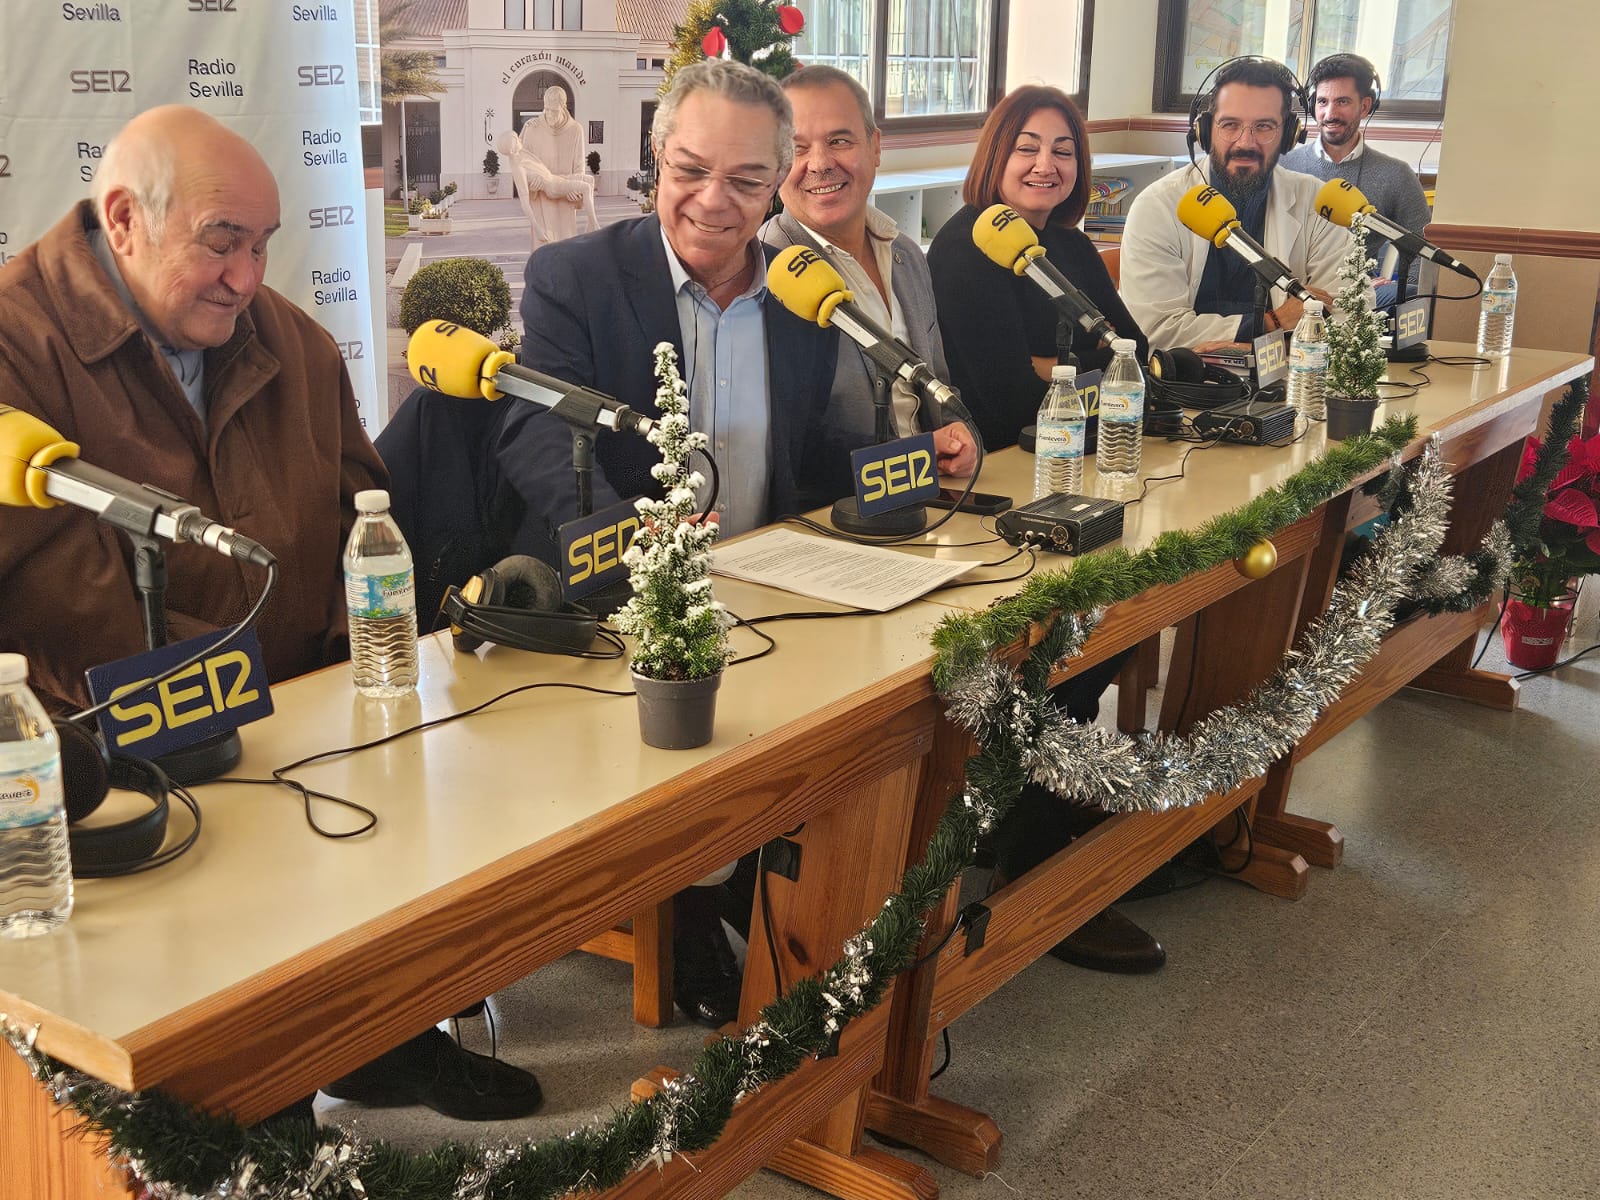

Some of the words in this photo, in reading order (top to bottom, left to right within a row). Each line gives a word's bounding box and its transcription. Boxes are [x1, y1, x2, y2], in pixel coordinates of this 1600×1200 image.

[62, 2, 121, 21] Sevilla
[292, 5, 338, 21] Sevilla
[188, 59, 236, 75] Radio
[510, 49, 552, 73] corazón
[70, 70, 132, 93] SER
[297, 65, 345, 87] SER
[189, 81, 244, 98] Sevilla
[302, 129, 342, 146] Radio
[303, 149, 348, 167] Sevilla
[1196, 186, 1221, 206] SE
[308, 205, 355, 229] SER
[991, 208, 1020, 232] SE
[787, 249, 824, 278] SE
[312, 268, 351, 285] Radio
[314, 287, 358, 306] Sevilla
[1398, 309, 1425, 340] SER
[338, 340, 364, 361] ER
[1257, 340, 1286, 377] SER
[861, 449, 934, 503] SER
[109, 650, 259, 747] SER
